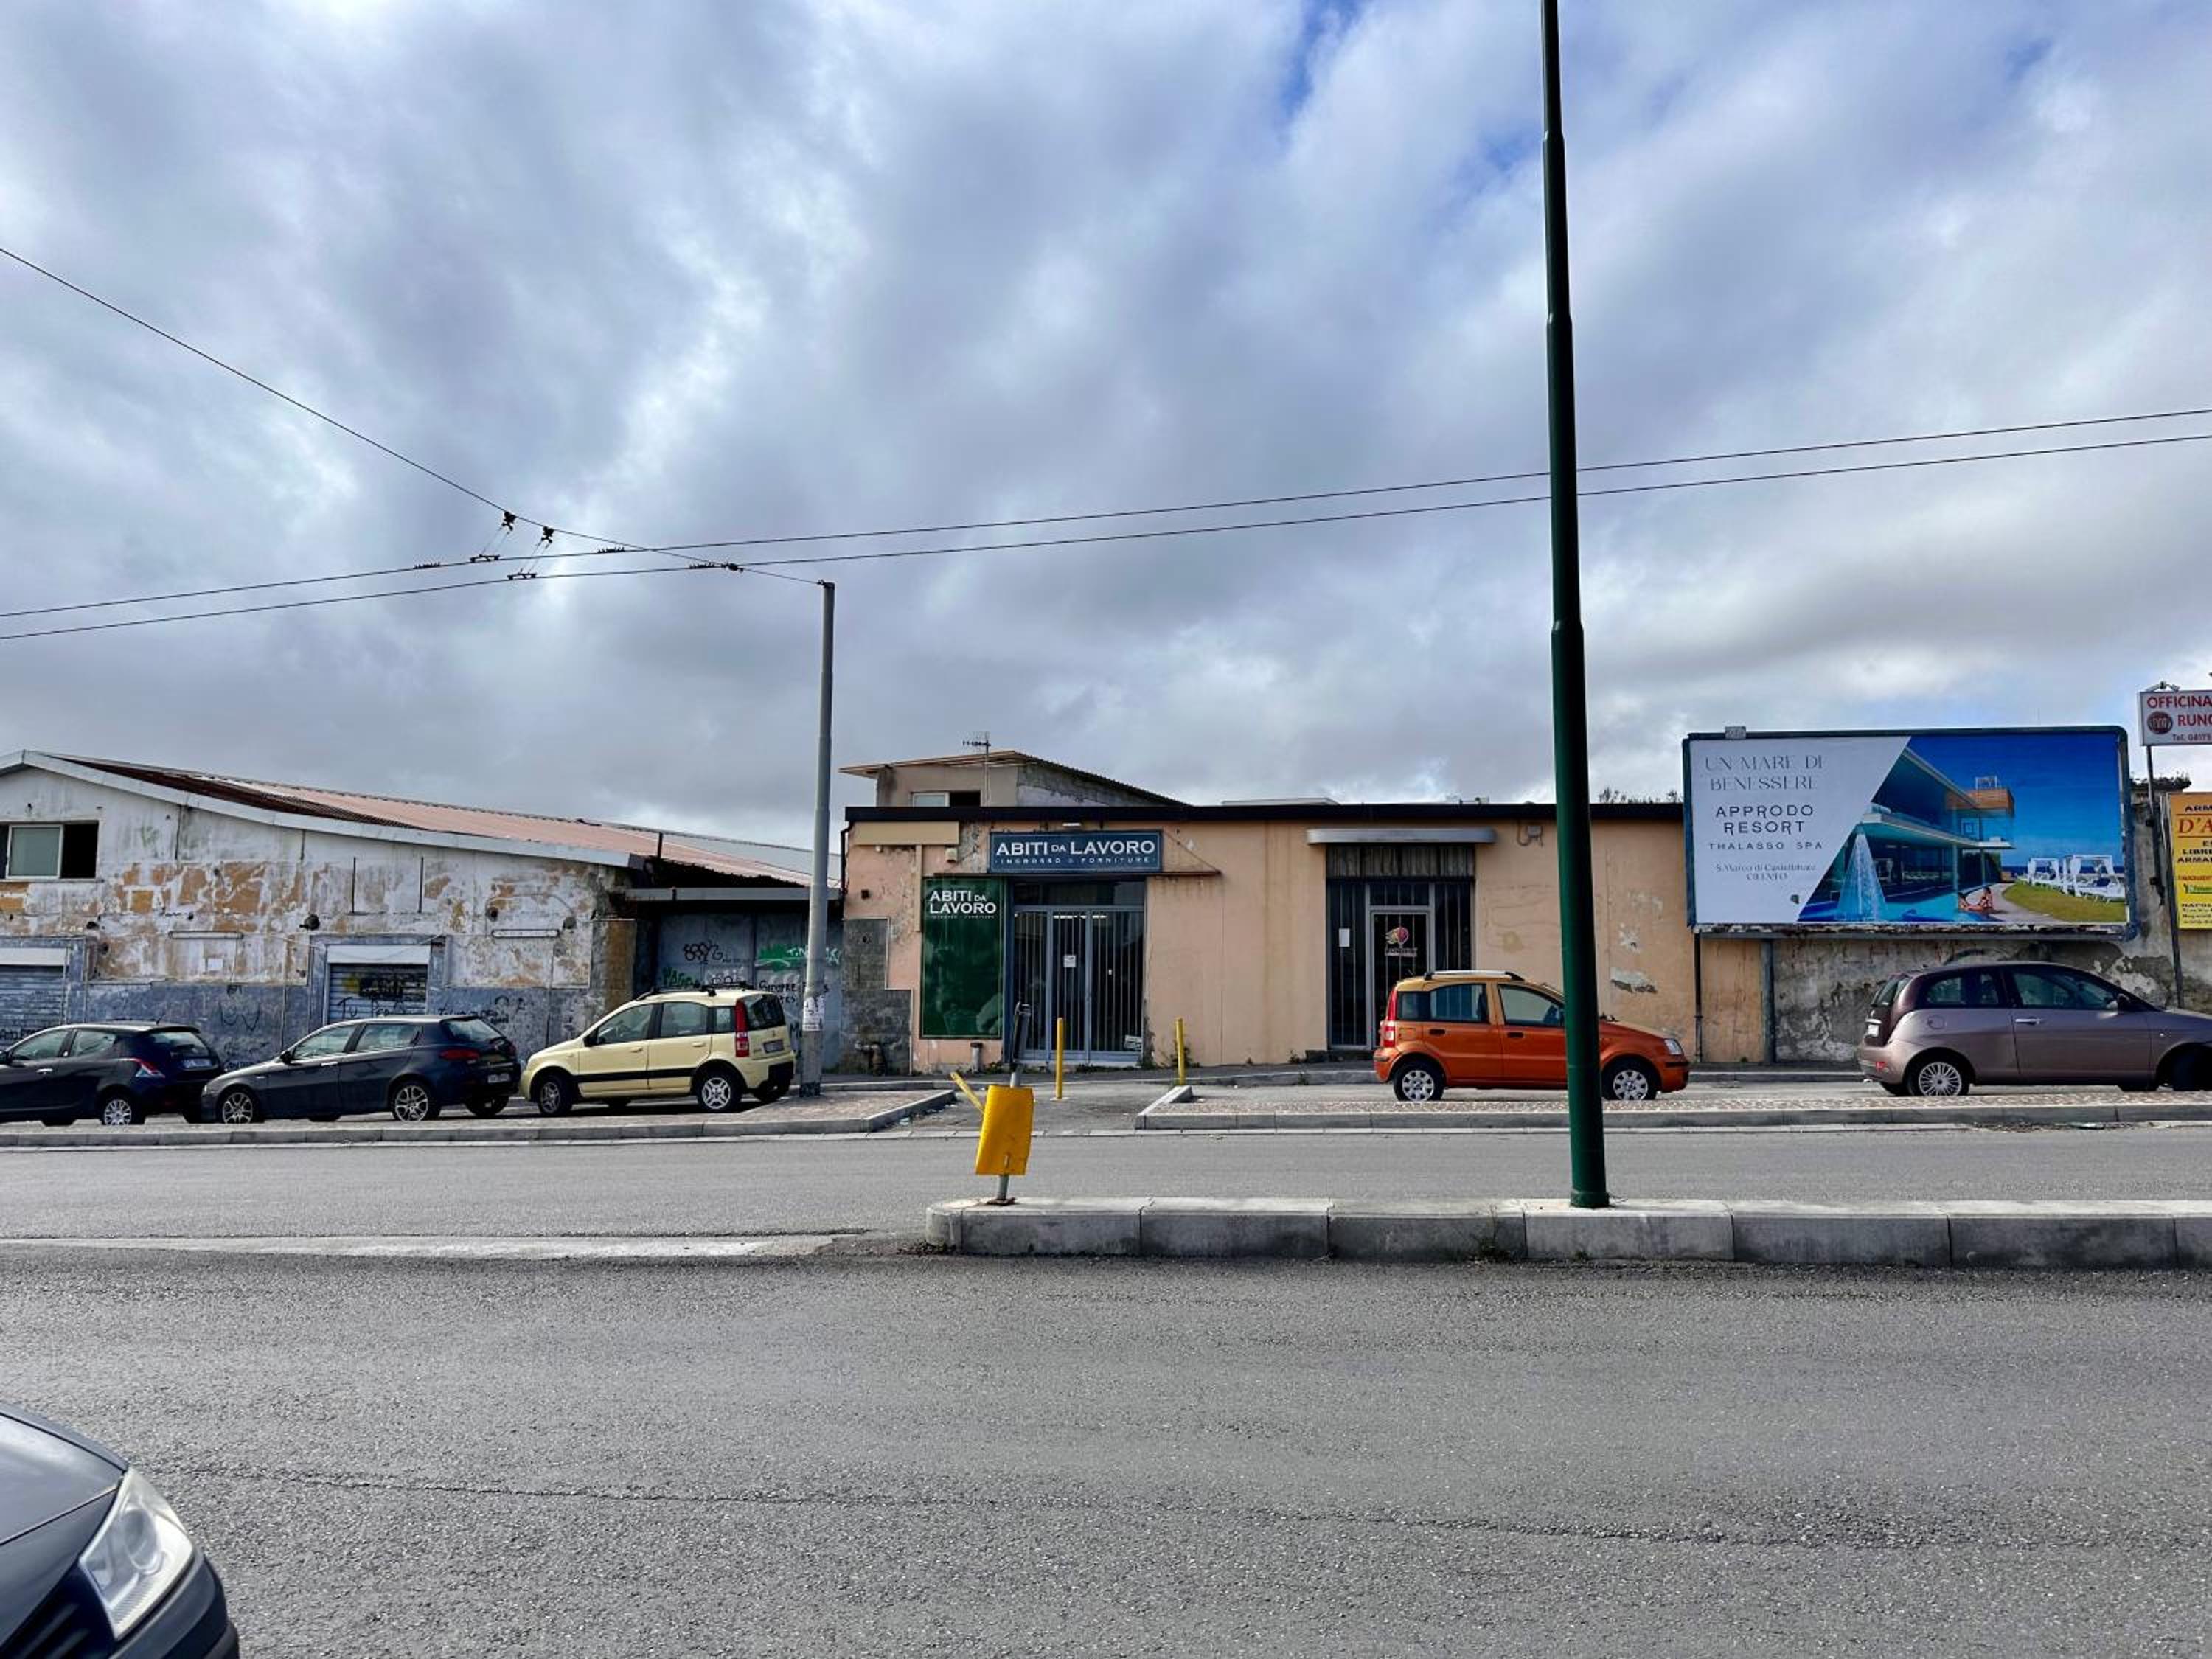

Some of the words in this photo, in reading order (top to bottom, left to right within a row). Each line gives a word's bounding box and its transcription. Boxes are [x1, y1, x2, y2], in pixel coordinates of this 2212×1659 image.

[2146, 695, 2212, 709] OFFICINA
[1806, 754, 1823, 769] DI
[1716, 804, 1814, 818] APPRODO
[1724, 821, 1806, 835] RESORT
[996, 841, 1048, 856] ABITI
[1051, 844, 1067, 852] DA
[1070, 840, 1155, 855] LAVORO
[1709, 841, 1784, 850] THALASSO
[1796, 841, 1823, 849] SPA
[930, 890, 971, 901] ABITI
[930, 902, 996, 914] LAVORO
